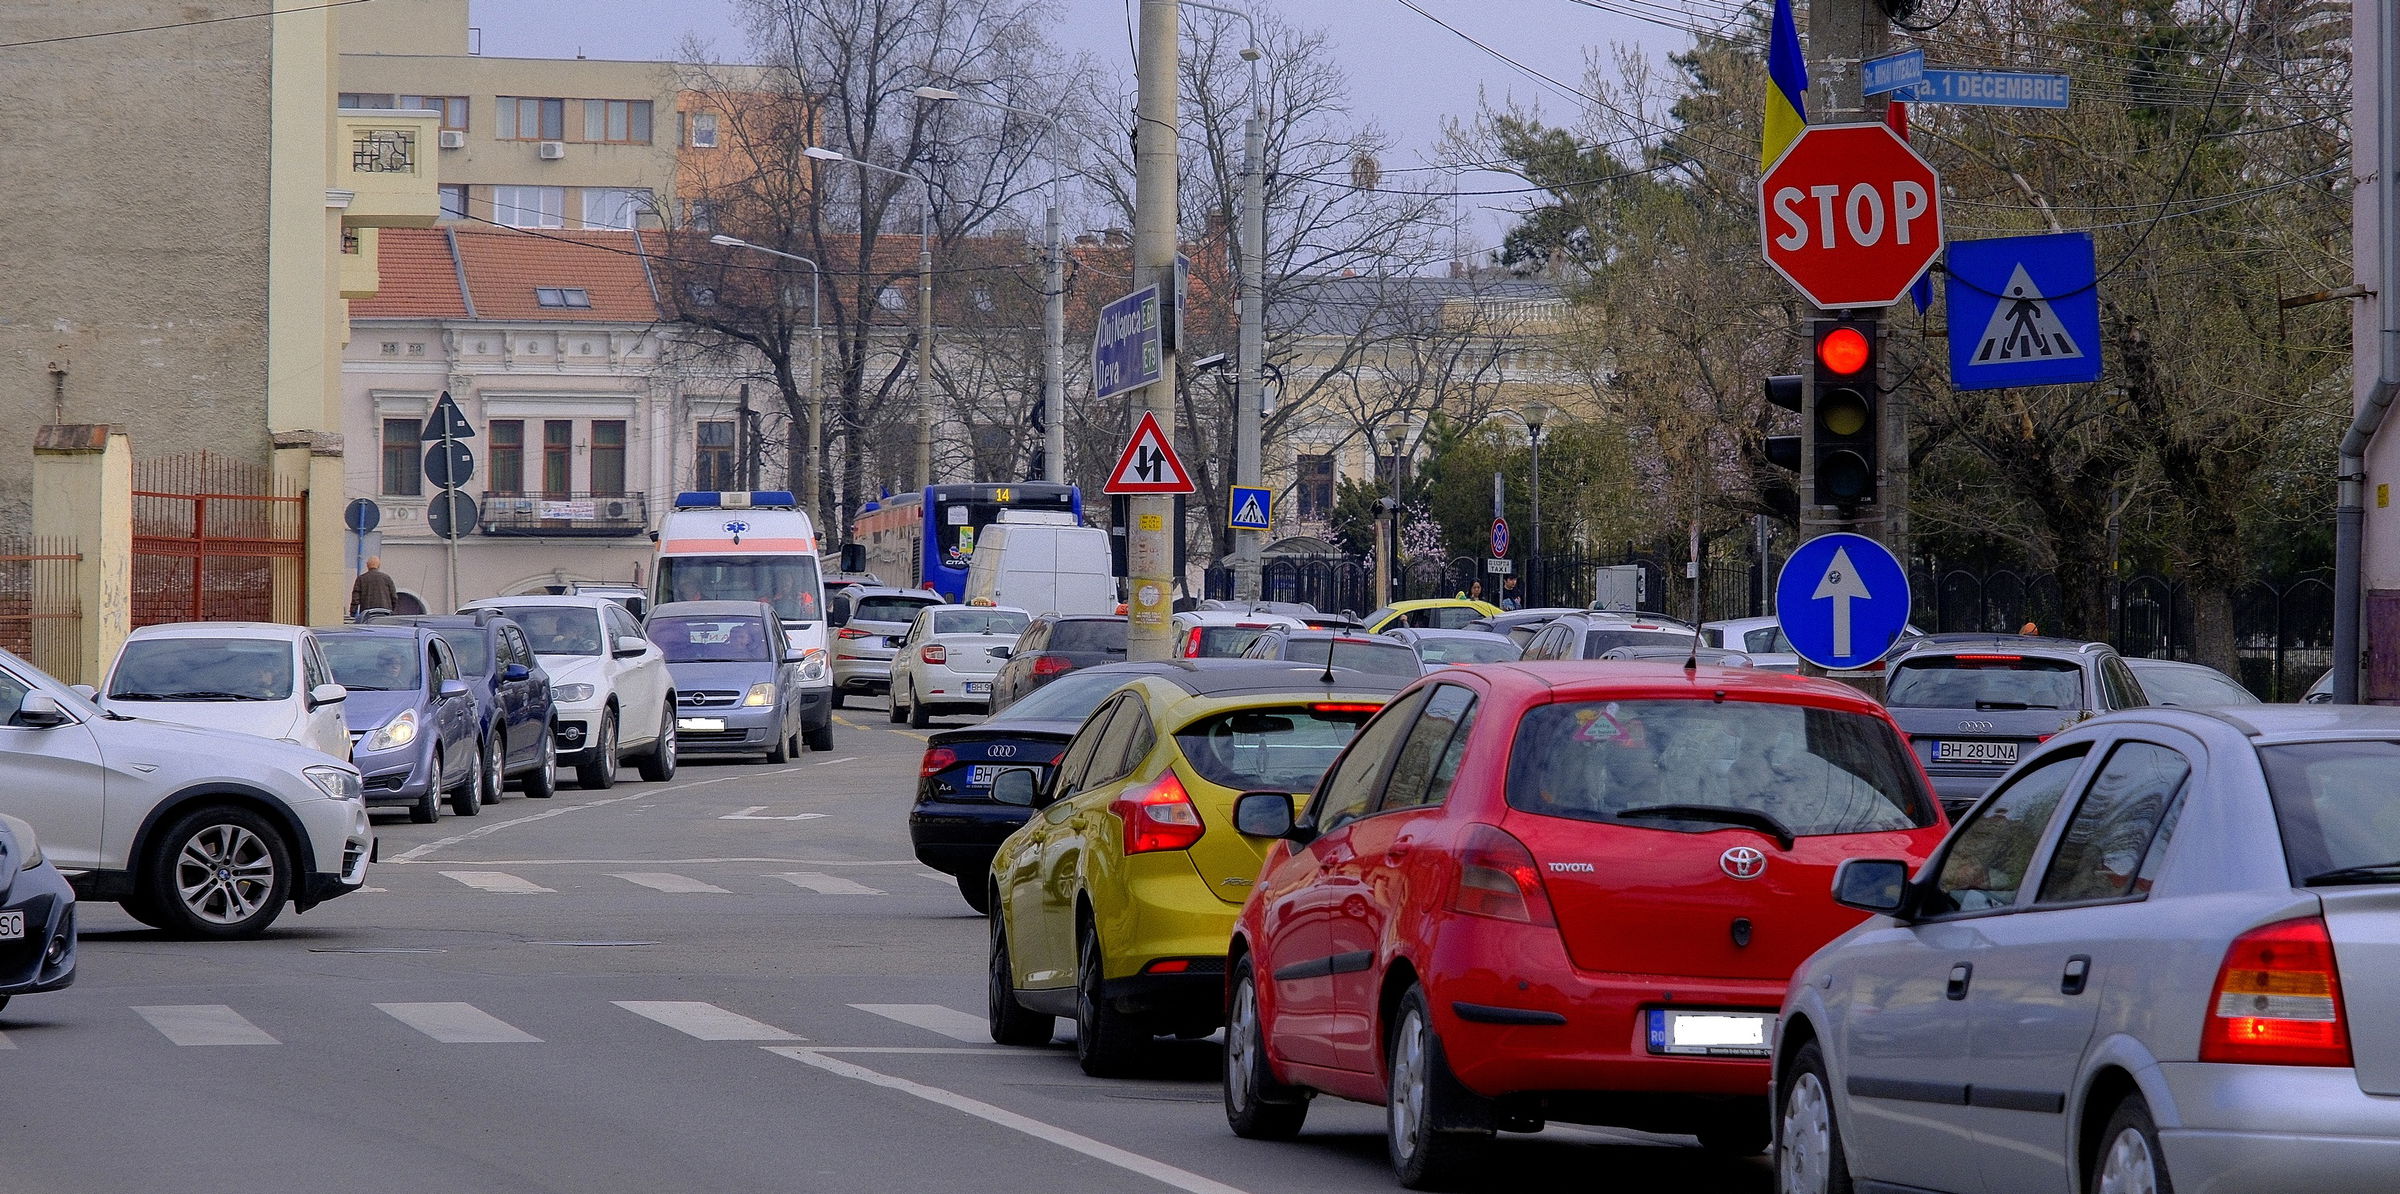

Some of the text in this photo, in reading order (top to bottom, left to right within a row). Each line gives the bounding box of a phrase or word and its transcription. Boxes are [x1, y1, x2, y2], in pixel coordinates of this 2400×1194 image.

[1875, 62, 1892, 85] MIHAI
[1892, 56, 1920, 82] VITEAZUL
[1942, 75, 1951, 94] 1
[1958, 75, 2064, 101] DECEMBRIE
[1773, 180, 1928, 252] STOP
[1100, 309, 1141, 349] Cluj Napoca
[1098, 359, 1120, 390] Deva
[995, 487, 1010, 502] 14
[1941, 743, 1962, 757] BH
[974, 767, 993, 782] BH
[938, 783, 952, 791] A4
[1548, 862, 1594, 873] TOYOTA
[1650, 1030, 1665, 1042] RO
